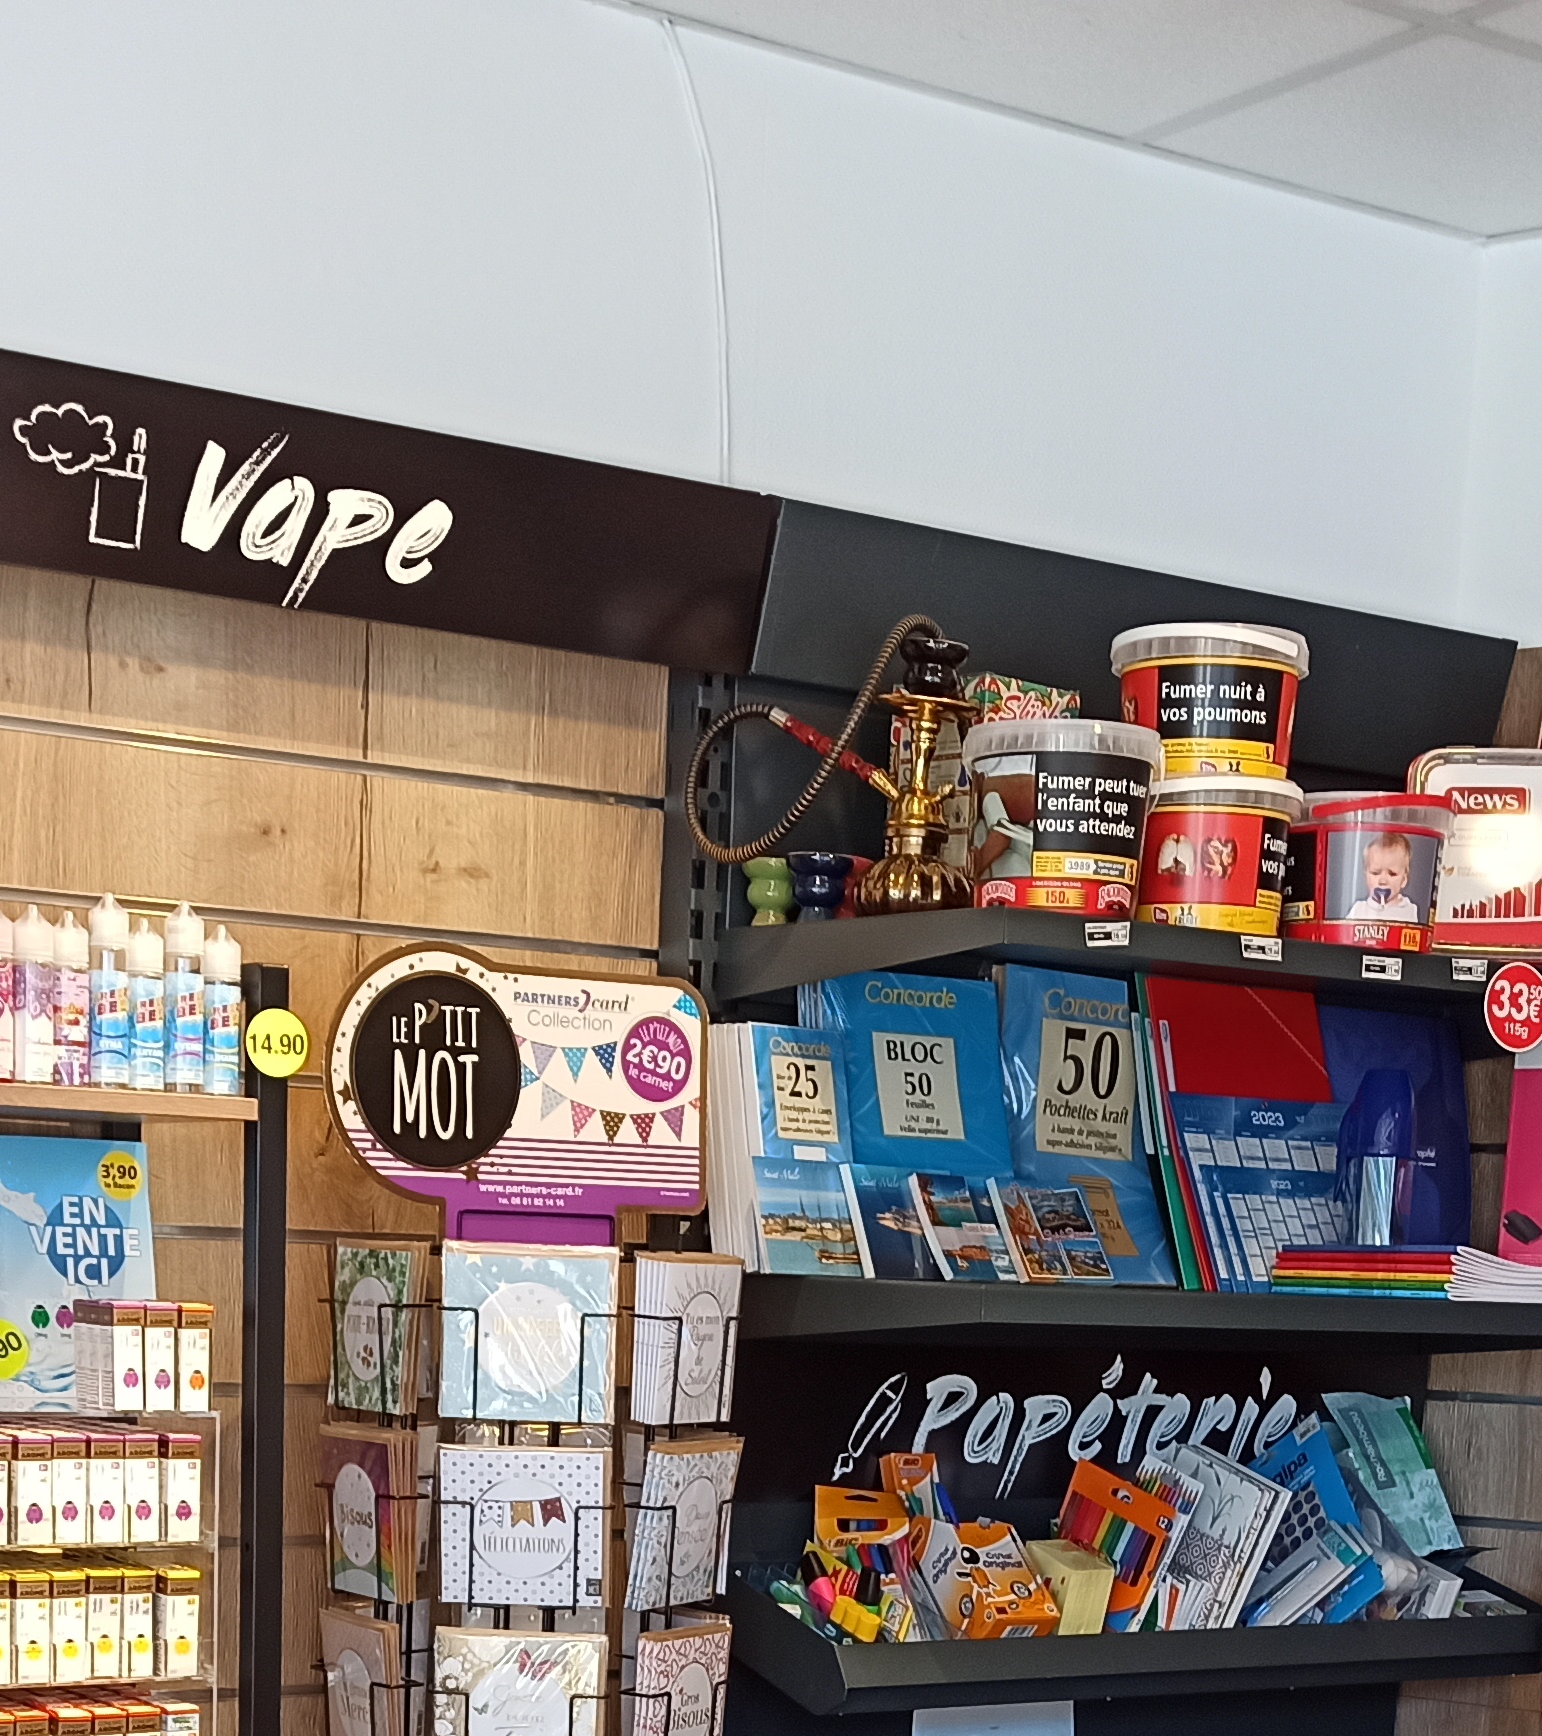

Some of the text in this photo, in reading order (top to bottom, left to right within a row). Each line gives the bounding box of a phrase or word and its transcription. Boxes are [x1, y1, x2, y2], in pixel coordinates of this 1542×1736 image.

[180, 428, 454, 609] Vape
[1161, 681, 1266, 702] Fumer nuit à
[1161, 706, 1267, 726] vos poumons
[1038, 772, 1091, 793] Fumer
[1095, 777, 1126, 798] peut
[1038, 795, 1129, 818] l'enfant que
[1451, 790, 1519, 812] News
[1037, 816, 1136, 839] vous attendez
[1354, 925, 1388, 942] STANLEY
[864, 980, 957, 1010] Concorde
[392, 1016, 408, 1044] LE
[527, 1010, 613, 1032] Collection
[247, 1032, 305, 1056] 14.90
[769, 1036, 832, 1058] Concorde
[885, 1039, 944, 1065] BLOC
[626, 1038, 686, 1081] 2€90
[1057, 1027, 1121, 1100] 50
[786, 1062, 819, 1100] 25
[904, 1071, 932, 1097] 50
[393, 1049, 479, 1140] MOT
[1043, 1098, 1129, 1125] Pochettes kraft
[1251, 1110, 1285, 1127] 2023
[63, 1196, 106, 1224] EN
[30, 1226, 142, 1258] VENTE
[66, 1257, 110, 1286] ICI
